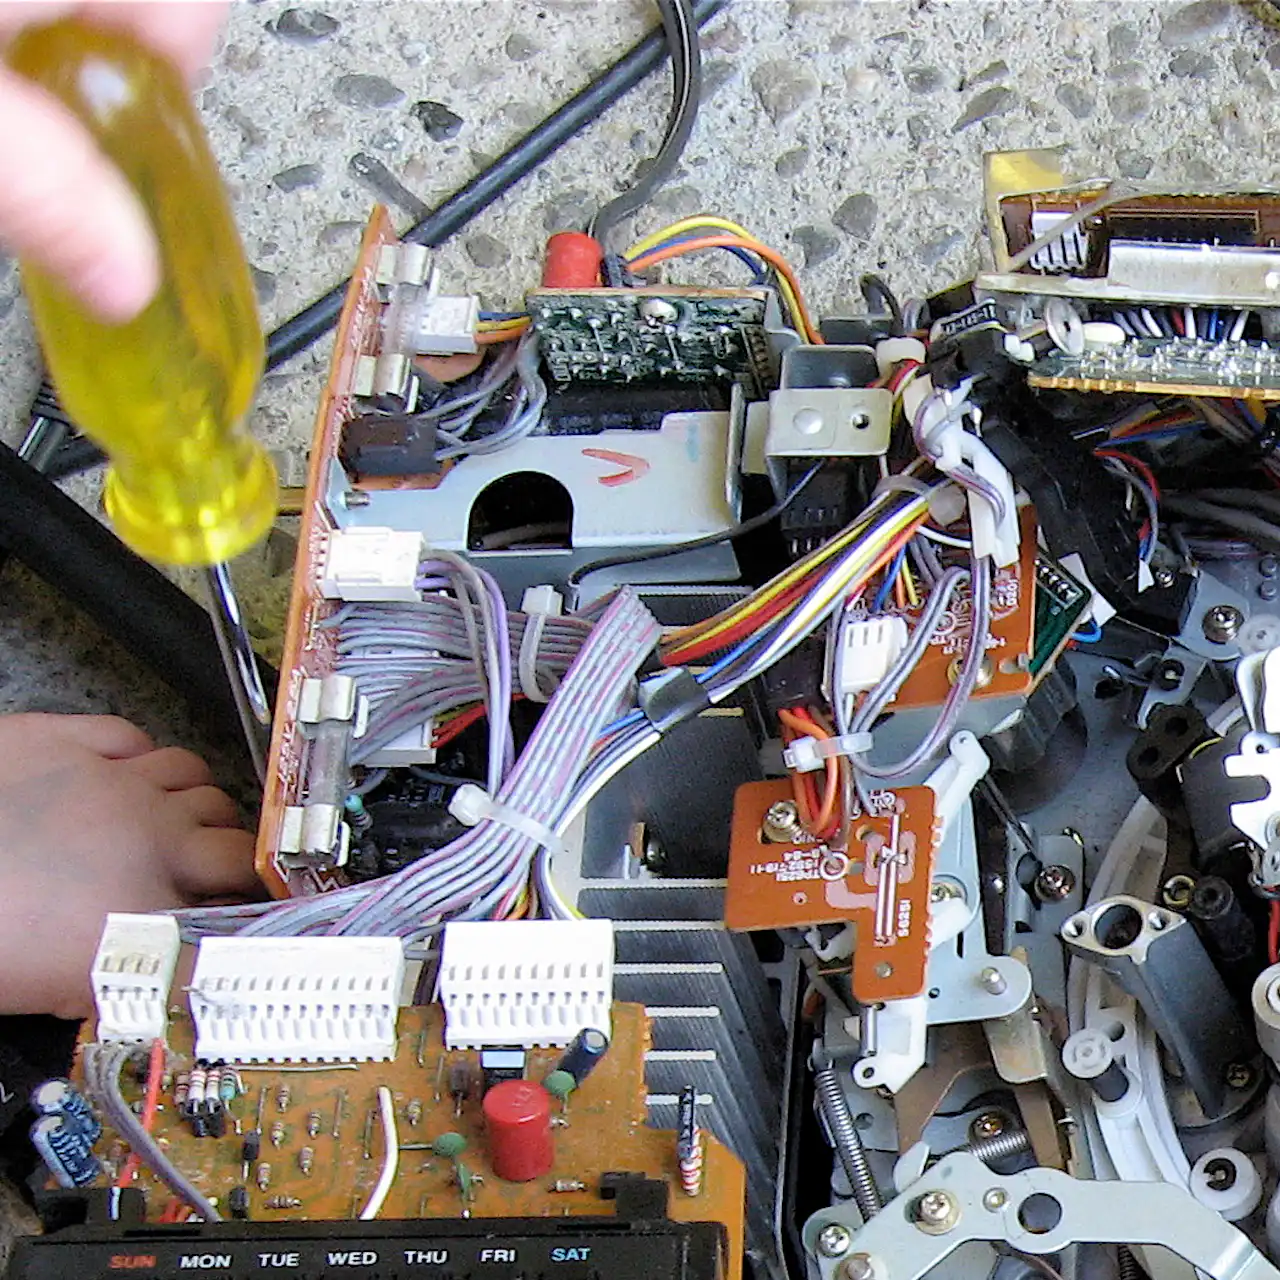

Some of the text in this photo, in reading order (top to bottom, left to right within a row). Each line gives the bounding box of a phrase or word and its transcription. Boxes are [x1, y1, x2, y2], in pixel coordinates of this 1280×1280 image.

[109, 1247, 591, 1269] SUN MON TUE WED THU FRI SAT
